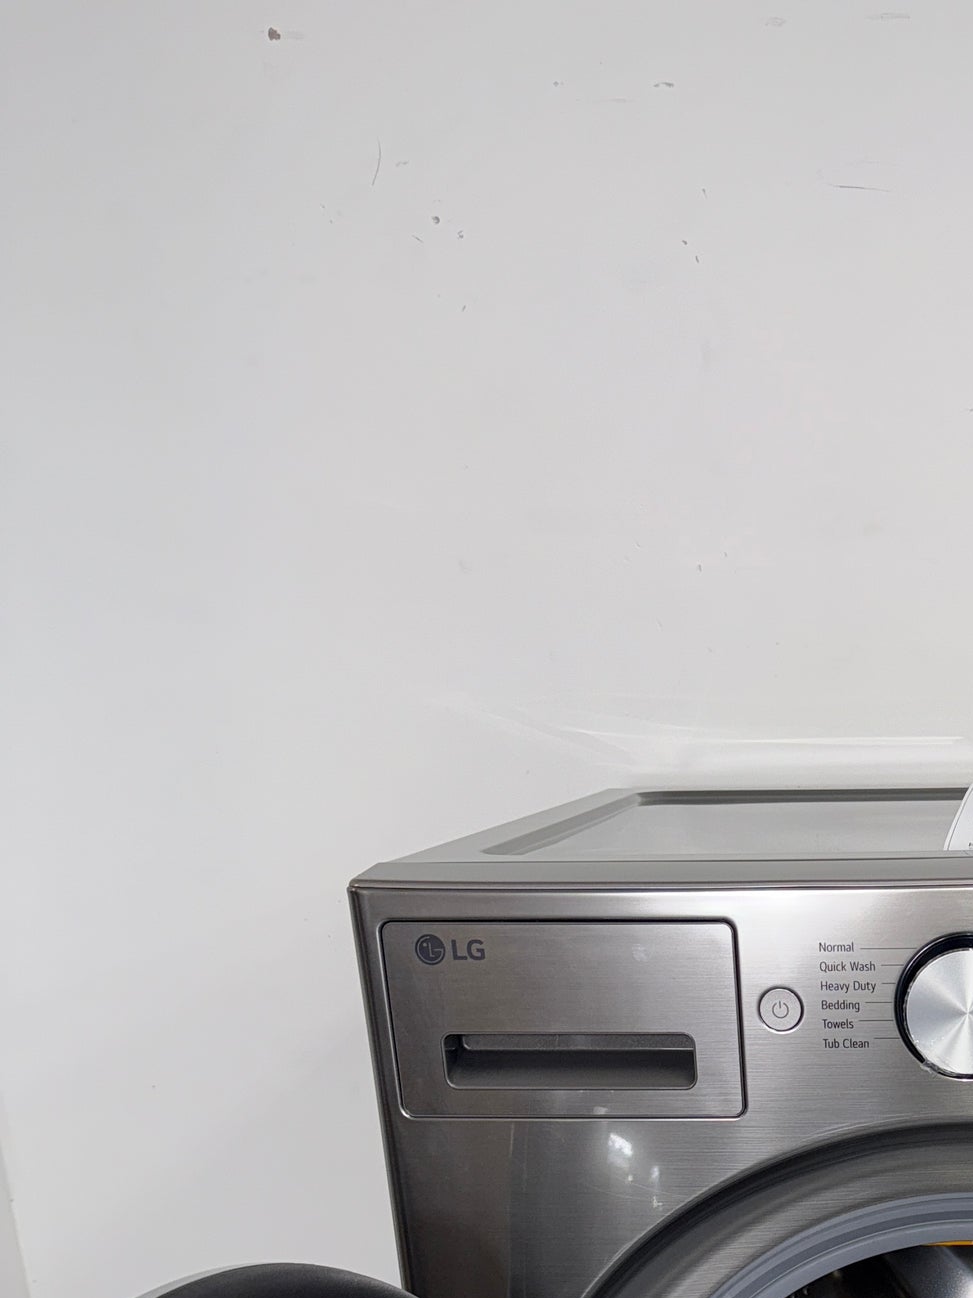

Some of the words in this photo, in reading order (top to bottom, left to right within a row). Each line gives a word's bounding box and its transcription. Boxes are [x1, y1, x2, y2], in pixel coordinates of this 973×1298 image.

[451, 939, 486, 961] LG
[819, 942, 855, 953] Normal
[820, 961, 847, 973] Quick
[850, 961, 876, 972] Wash
[820, 981, 850, 993] Heavy
[853, 981, 876, 993] Duty
[821, 1000, 860, 1013] Bedding
[822, 1019, 854, 1030] Towels
[823, 1038, 840, 1049] Tub
[842, 1038, 870, 1049] Clean
